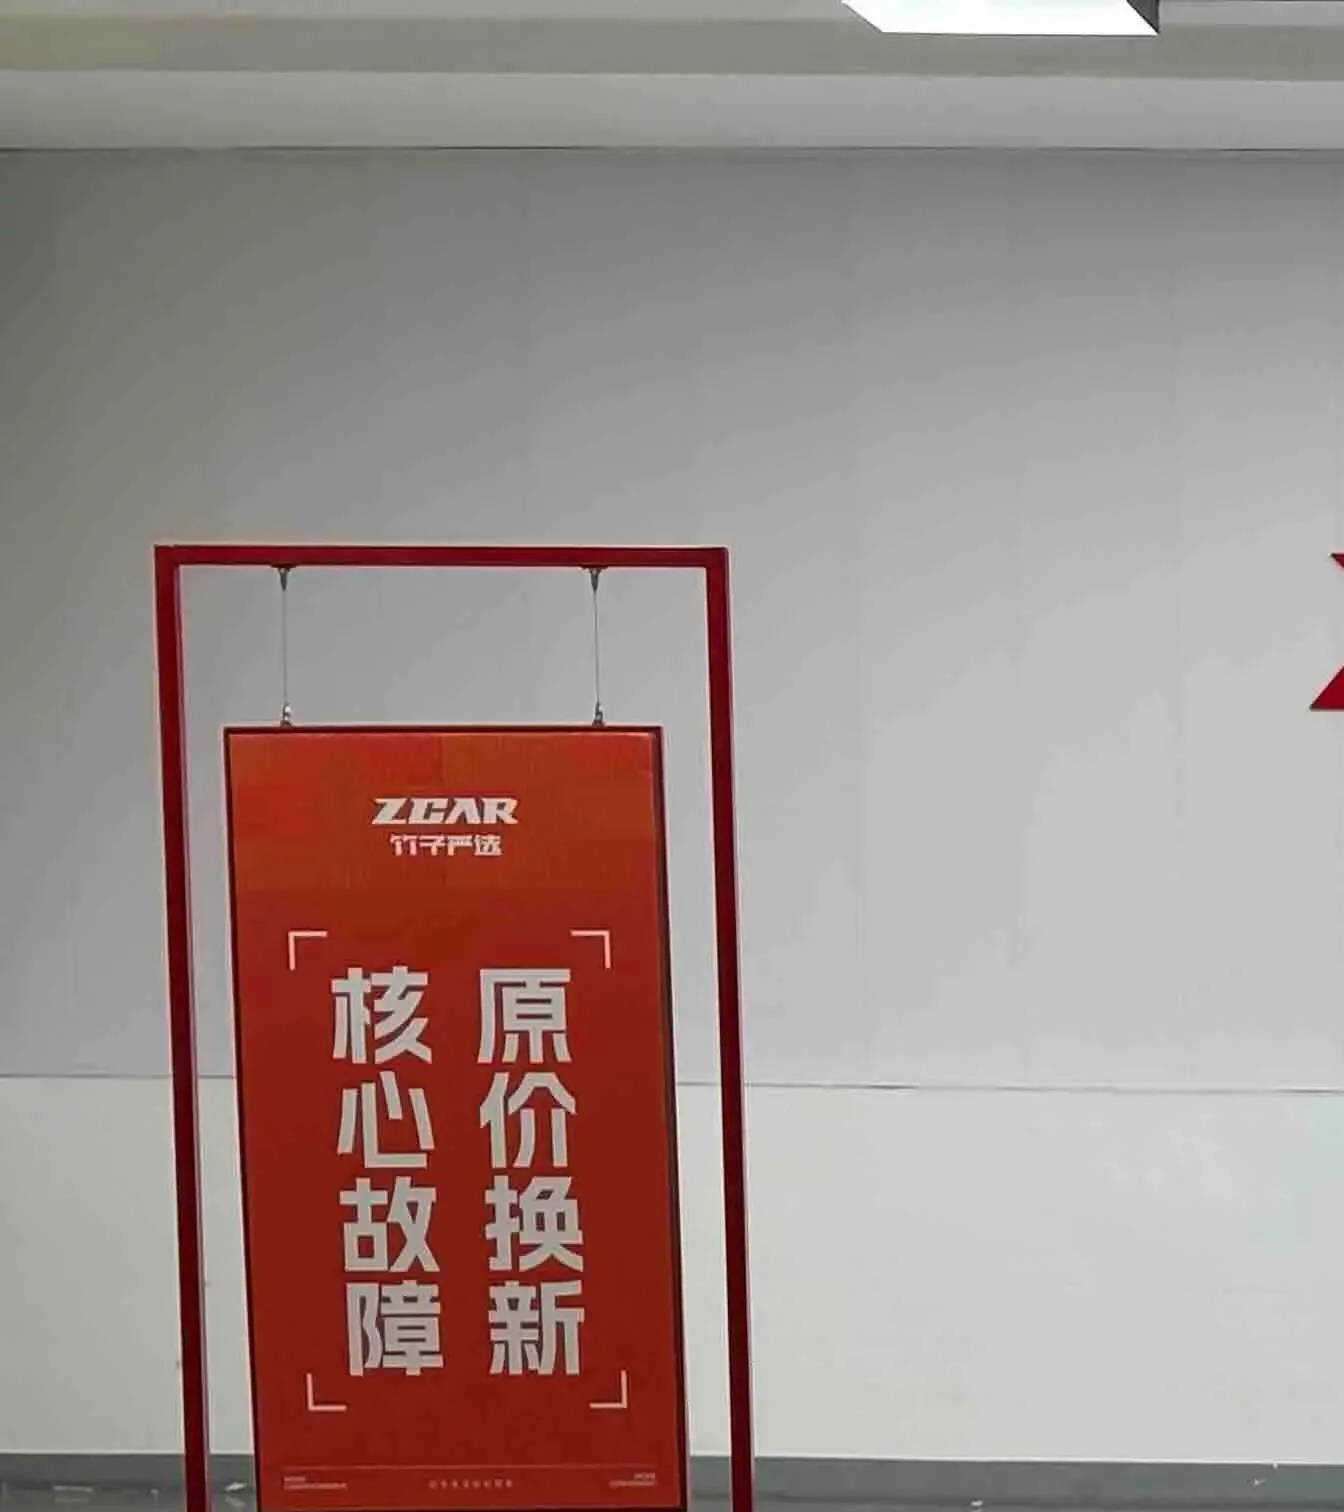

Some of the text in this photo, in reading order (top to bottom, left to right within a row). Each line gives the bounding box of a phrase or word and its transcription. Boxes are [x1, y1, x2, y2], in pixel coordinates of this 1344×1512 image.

[370, 796, 519, 826] ZCAR
[389, 833, 503, 857] 竹子严选
[330, 965, 445, 1378] 核心故障
[477, 967, 587, 1376] 原价换新
